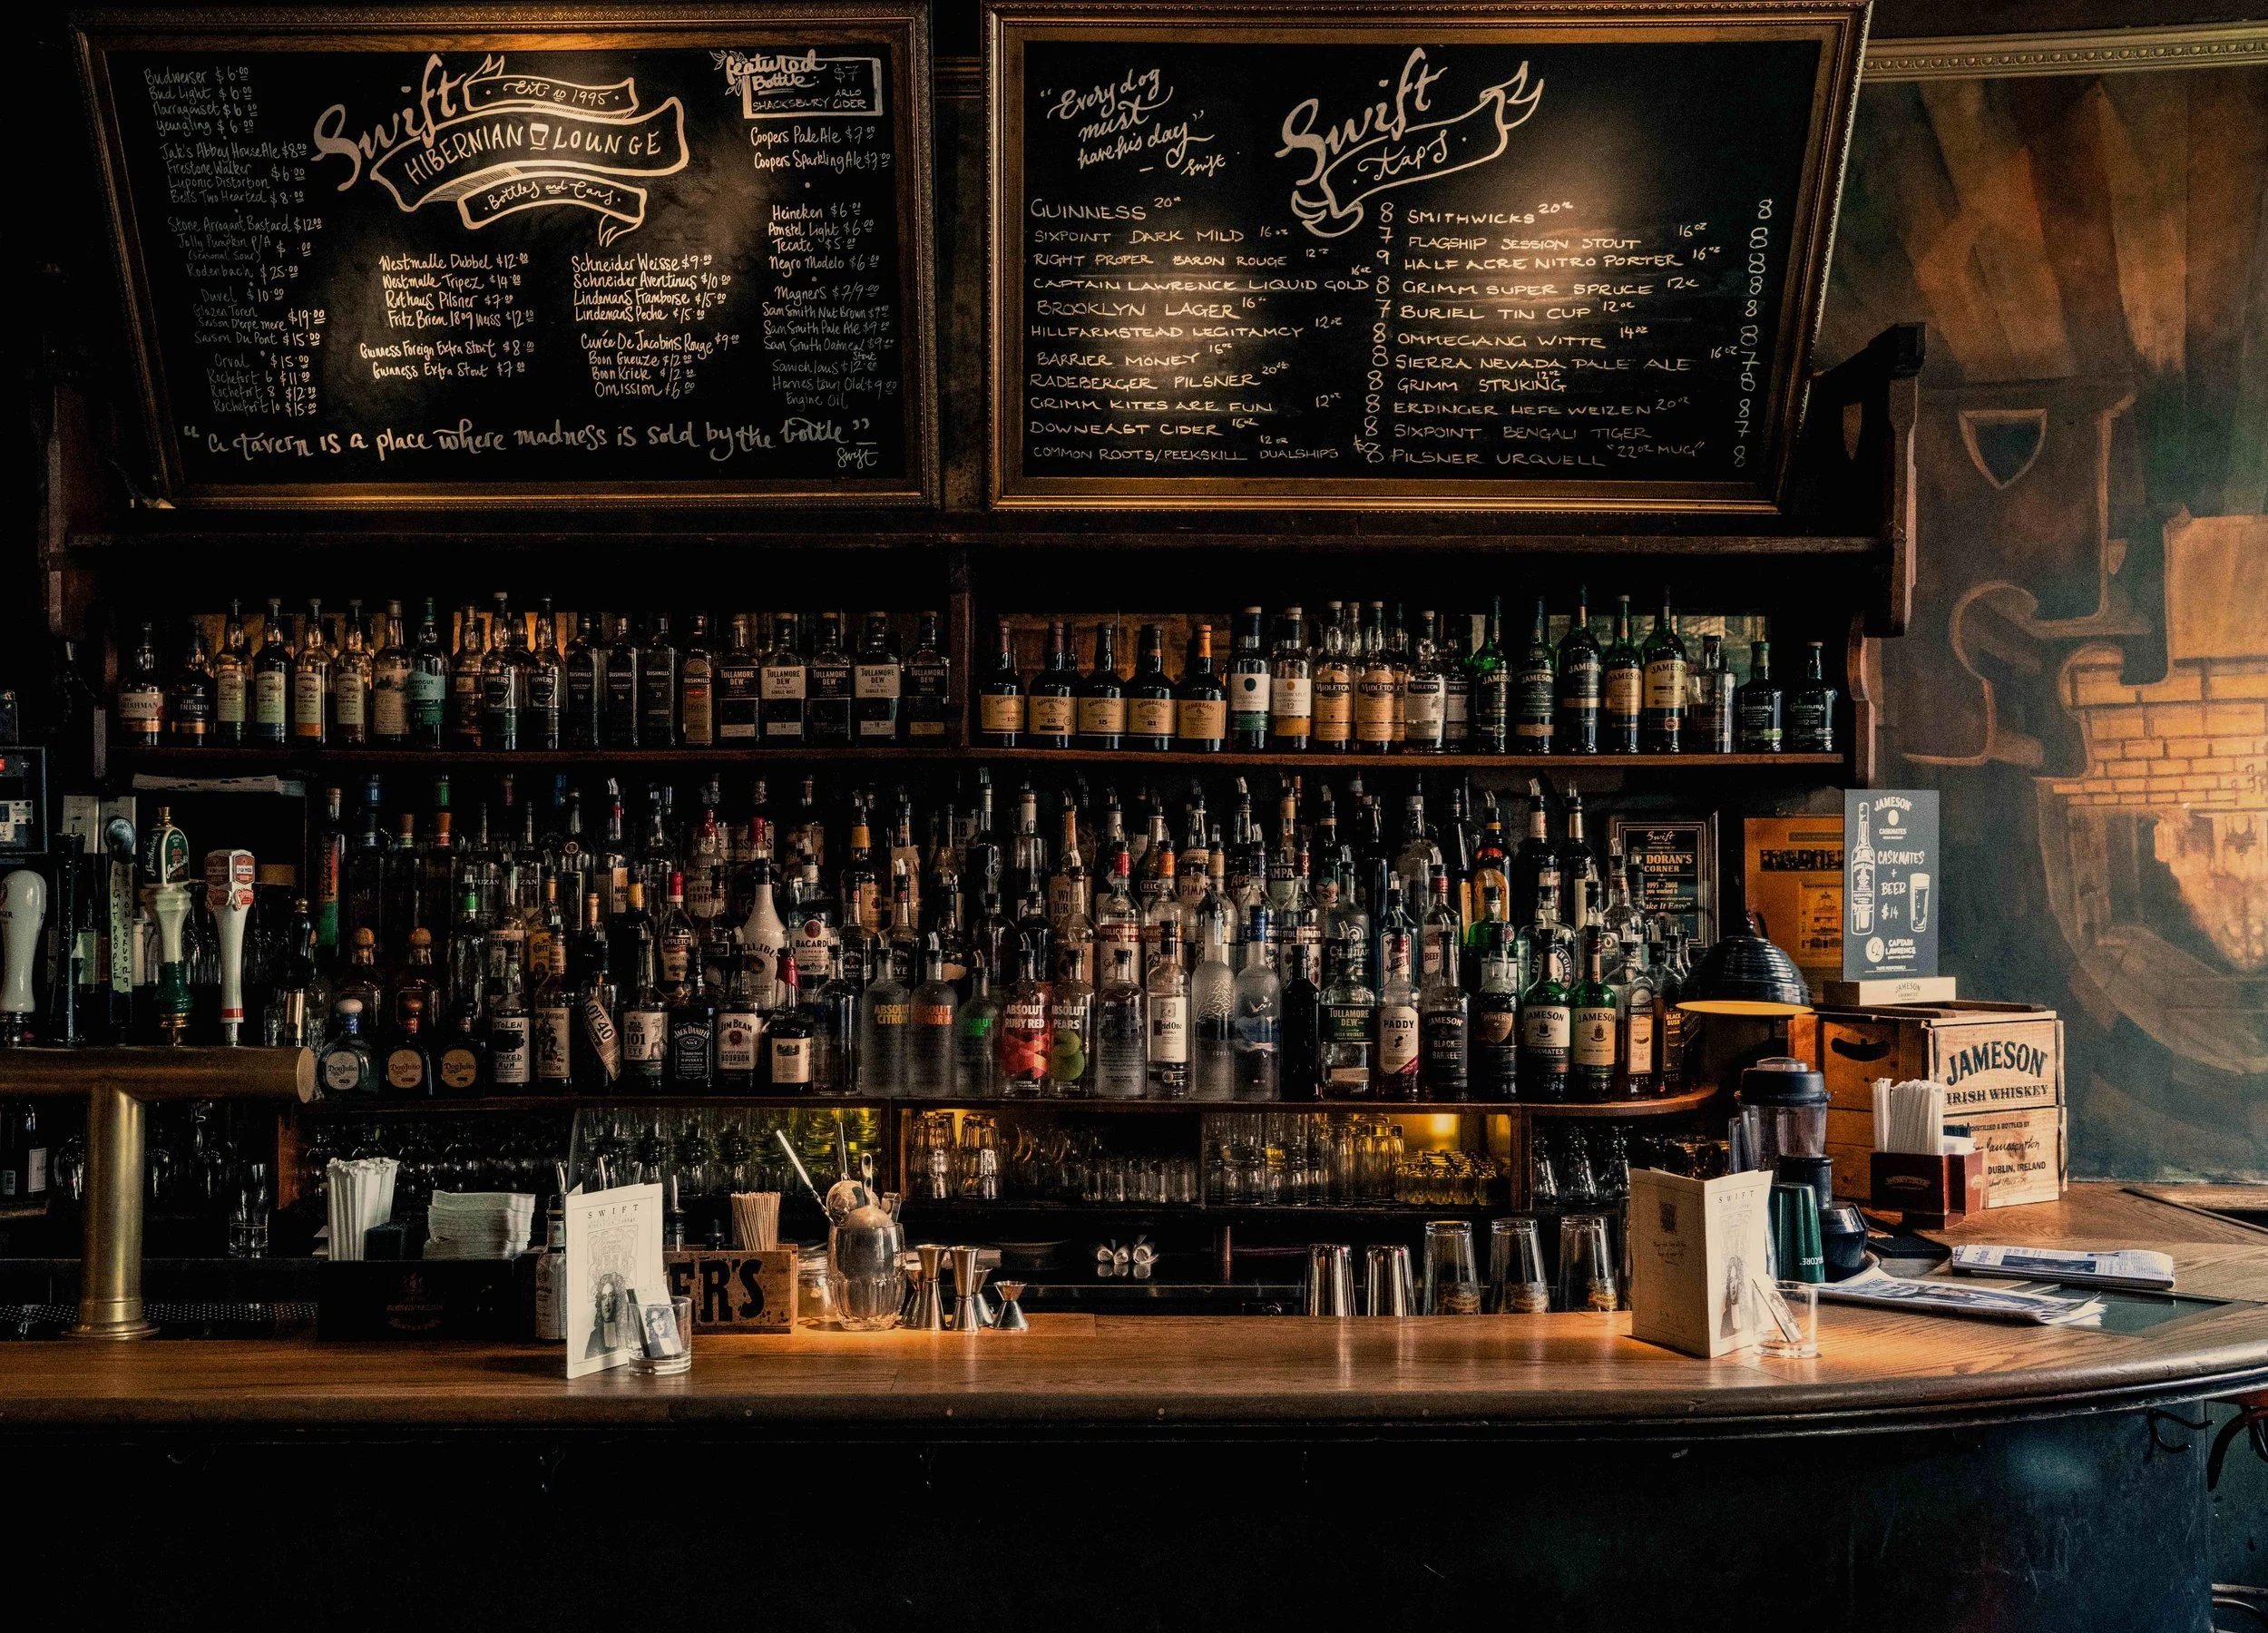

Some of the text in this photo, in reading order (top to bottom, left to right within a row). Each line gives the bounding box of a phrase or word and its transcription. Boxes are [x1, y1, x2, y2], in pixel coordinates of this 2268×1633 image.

[834, 64, 860, 83] $7
[1119, 68, 1160, 102] dog
[572, 89, 612, 106] 1995
[752, 97, 867, 112] SHACKSBURY CIDER
[1078, 86, 1174, 142] must
[1275, 46, 1449, 186] Swift
[310, 54, 466, 191] Swift
[405, 124, 661, 185] HIBERNIAN LOUNGE
[1077, 146, 1116, 171] have
[1114, 132, 1143, 160] his
[754, 150, 865, 174] Coopers Sparkling Ale
[488, 181, 540, 210] Bottles
[772, 202, 823, 221] Heineken
[1031, 198, 1147, 221] GUINNESS
[1408, 210, 1535, 224] SMITHWICKS
[767, 220, 839, 243] Amstel Light
[1034, 229, 1245, 244] SIXPOINT DARK MILD
[772, 237, 815, 254] Tecate
[1408, 236, 1642, 251] FLAGSHIP SESSION STOUT
[379, 253, 493, 271] Westmalle Dubbel
[1033, 253, 1288, 269] RIGHT PROPER BARON ROUGE
[1404, 254, 1685, 271] HALF ACRE NITRO PORTER
[1033, 278, 1370, 292] CAPTAIN LAWRENCE LIQUID GOLD
[1402, 280, 1655, 296] GRIMM SUPER SPRUCE
[774, 286, 827, 307] Magners
[1037, 299, 1242, 319] BROOKLYN LAGER
[1400, 305, 1591, 320] BURIEL TIN CUP
[617, 333, 635, 349] De
[684, 333, 714, 360] Rouge
[1397, 333, 1607, 349] OMMEGANG WITTE
[1037, 352, 1201, 367] BARRIER MONEY
[1394, 354, 1698, 371] SIERRA NEVADA PALE ALE
[594, 381, 663, 398] Omission
[1030, 373, 1263, 392] RADEBERGER PILSNER
[1030, 396, 1273, 413] GRIMM KITES ARE FUN
[1393, 402, 1651, 416] ERDINGER HEFE WEIZEN
[1030, 421, 1224, 436] DOWNEAST CIDER
[1393, 424, 1653, 442] SIXPOINT BENGALI TIGER
[231, 430, 314, 461] tavern
[376, 427, 434, 462] place
[432, 417, 507, 455] where
[513, 419, 607, 452] madness
[647, 421, 700, 448] sold
[706, 421, 735, 462] by
[735, 424, 776, 453] the
[1033, 446, 1093, 460] COMMON
[1259, 449, 1339, 460] DUALSHIPS
[1393, 447, 1607, 466] PILSNER URQUELL
[484, 676, 509, 684] POWERS
[532, 676, 553, 684] POWERS
[721, 670, 755, 679] TULLAMORE
[767, 670, 800, 678] TULLAMORE
[813, 670, 846, 679] TULLAMORE
[871, 676, 885, 684] DEW
[910, 669, 944, 677] TULLAMORE
[920, 676, 934, 684] DEW
[1874, 797, 1912, 812] JAMESON
[1646, 830, 1676, 842] Swift
[1646, 854, 1693, 865] DORAN'S
[1877, 850, 1924, 865] CASKMATES
[1644, 865, 1680, 873] CORNER
[1881, 881, 1906, 896] BEER
[1881, 903, 1899, 920] $14
[1006, 1004, 1044, 1015] ABSOLUT
[1329, 1008, 1369, 1018] TULLAMORE
[1526, 1012, 1564, 1022] JAMESON
[719, 1019, 753, 1033] JIM BEAM
[1004, 1018, 1045, 1029] RUBY RED
[1053, 1019, 1080, 1030] PEARS
[1341, 1018, 1359, 1026] DEW
[1383, 1020, 1414, 1029] PADDY
[1428, 1016, 1463, 1026] JAMESON
[626, 1033, 646, 1045] 101
[674, 1028, 689, 1038] JACK
[628, 1047, 643, 1055] RYE
[1433, 1040, 1456, 1048] BLACK
[720, 1053, 750, 1062] BOURBON
[1946, 1041, 2048, 1087] JAMESON
[1947, 1083, 2048, 1106] IRISH WHISKEY
[2017, 1160, 2047, 1172] IRELAND
[1718, 1189, 1755, 1205] SWIFT
[588, 1203, 640, 1219] SWIFT
